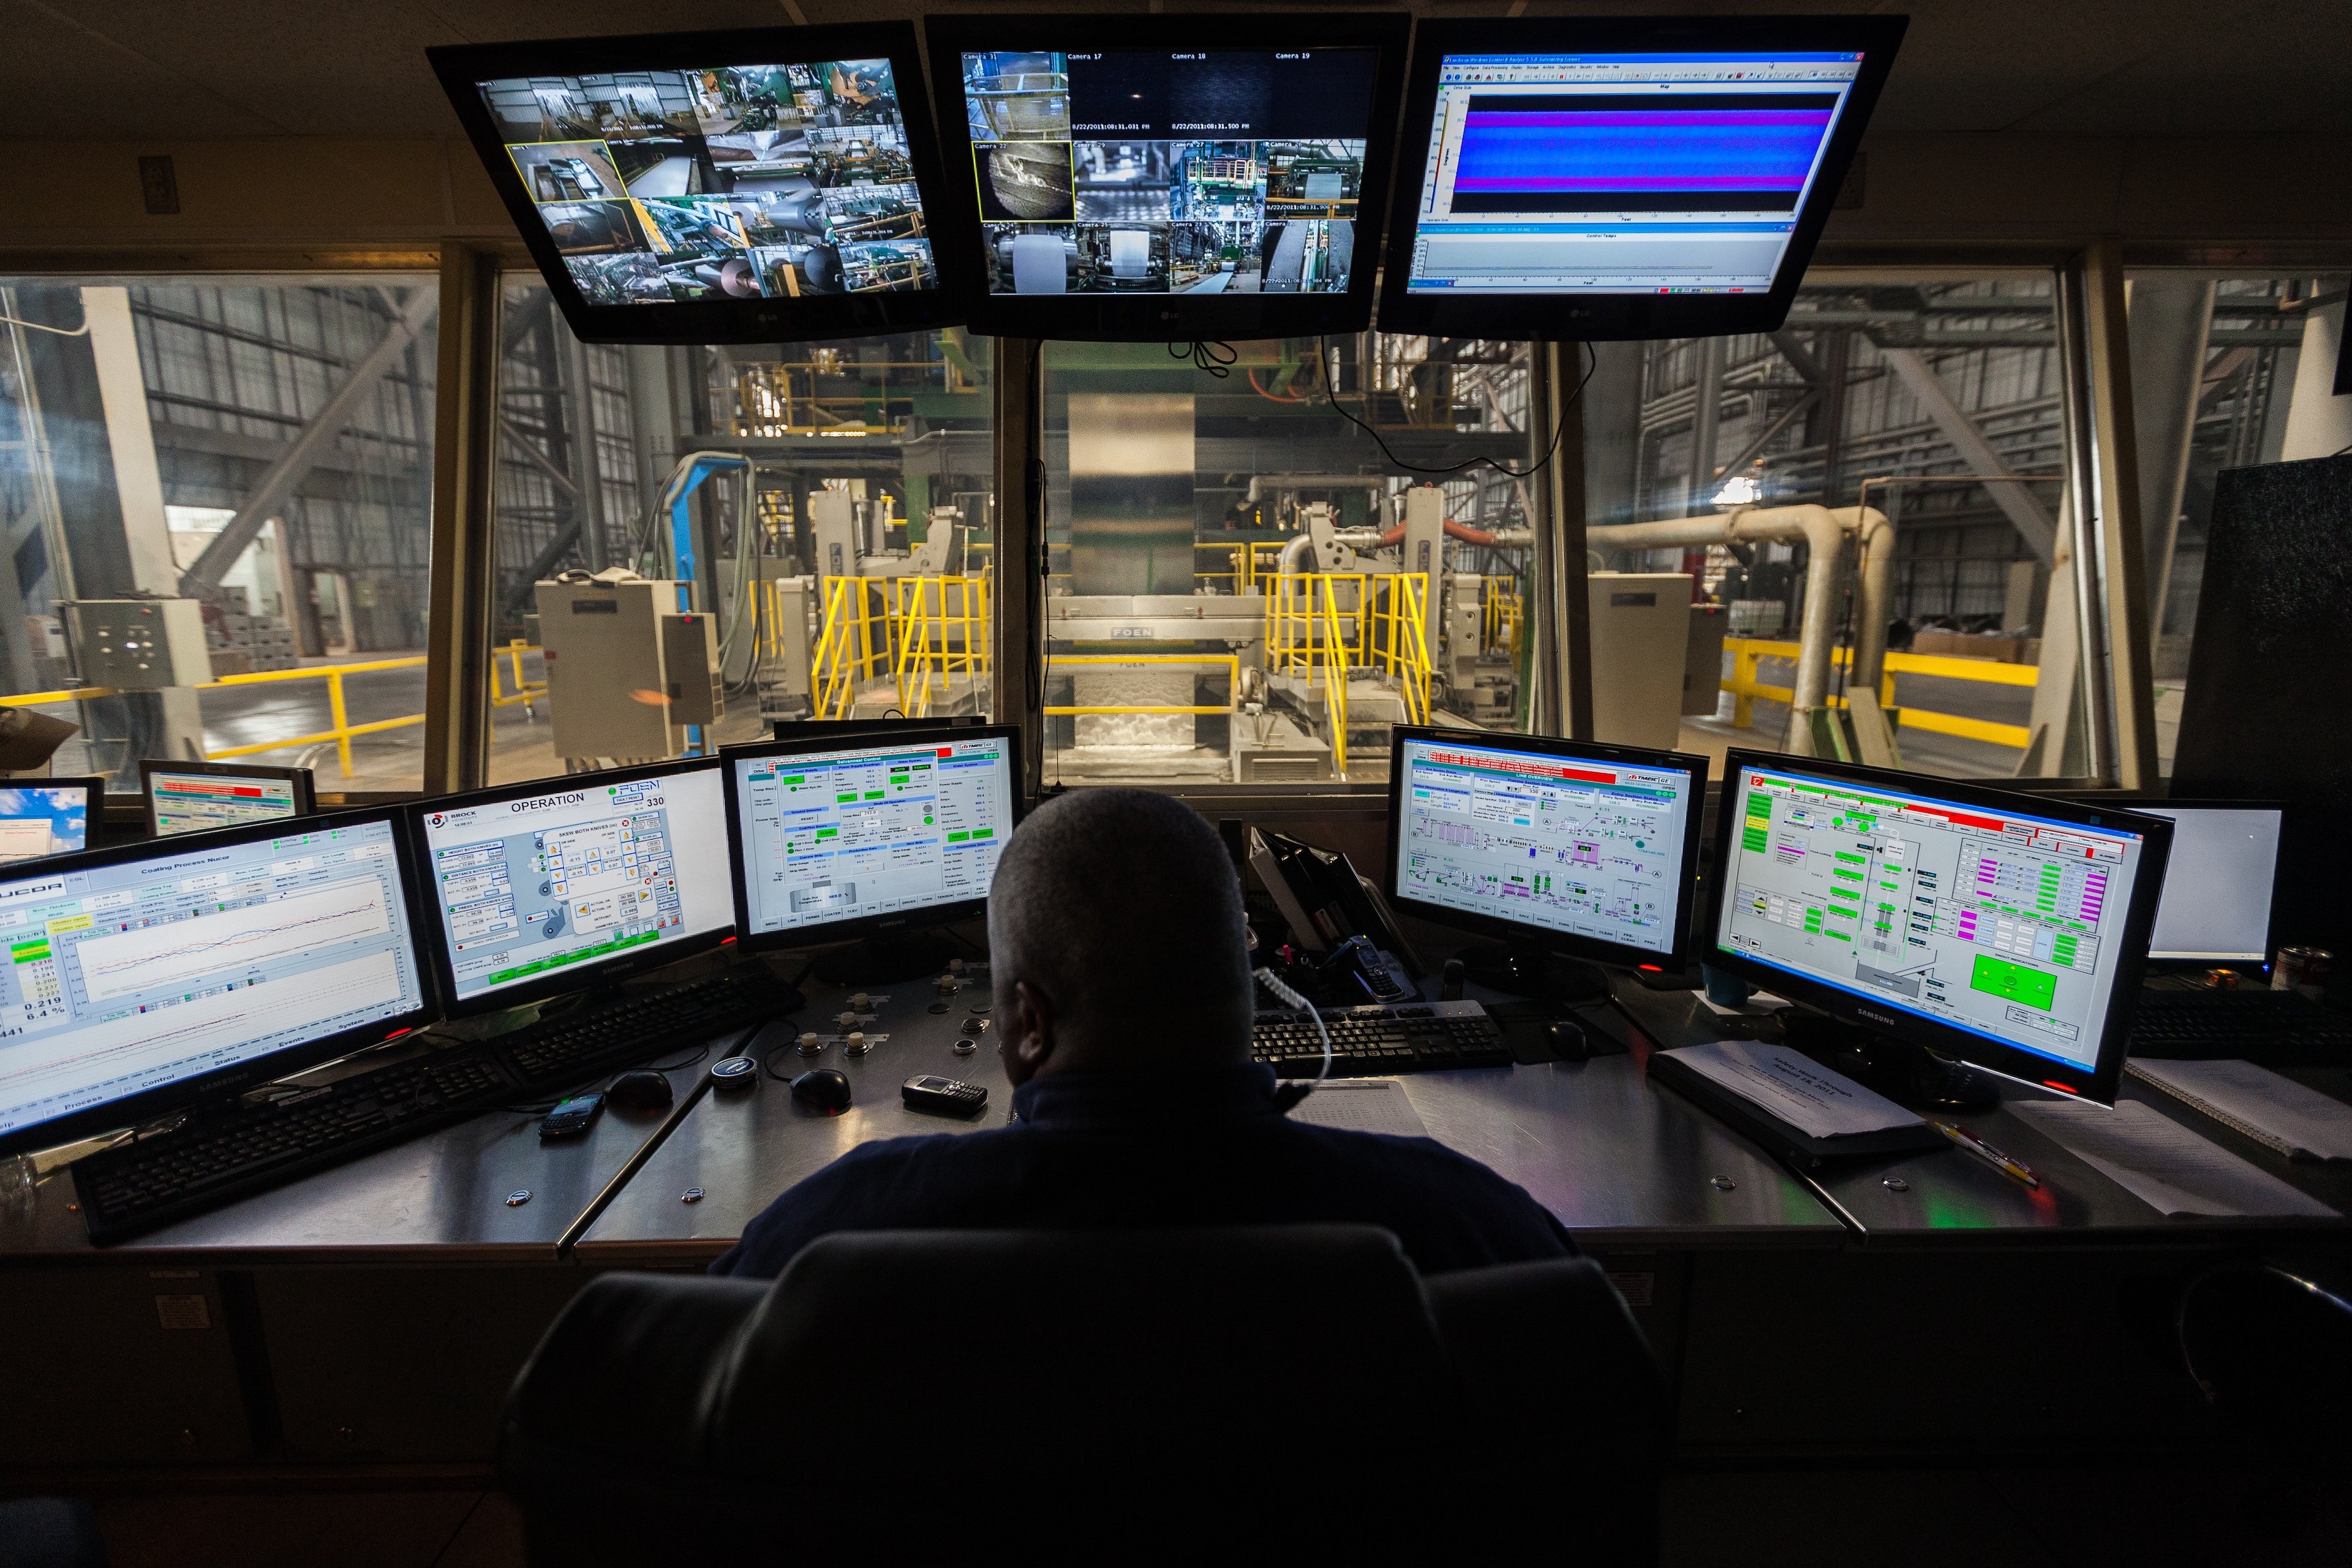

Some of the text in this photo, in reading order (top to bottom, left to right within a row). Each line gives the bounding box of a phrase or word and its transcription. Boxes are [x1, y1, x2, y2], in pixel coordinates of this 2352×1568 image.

[511, 793, 585, 813] OPERATION
[647, 797, 664, 807] 330
[451, 810, 477, 819] BROCK
[141, 865, 173, 874] Coating
[175, 859, 206, 868] Process
[0, 883, 62, 897] UCOR
[879, 919, 906, 928] SAMSUNG
[18, 947, 45, 956] Scanning
[518, 964, 541, 974] OPERATION
[603, 961, 635, 975] SAMSUNG
[2009, 957, 2039, 968] INDICATIONS
[39, 990, 60, 998] 0.223
[24, 997, 61, 1011] 0.219
[27, 1010, 48, 1020] 6.4
[1858, 1008, 1895, 1026] SAMSUNG
[338, 1018, 364, 1030] System
[279, 1036, 305, 1047] Events
[214, 1054, 241, 1066] Status
[141, 1074, 175, 1088] Control
[199, 1073, 249, 1092] SAMSUNG
[1772, 1063, 1836, 1096] August 18, 2011
[1774, 1057, 1853, 1098] Safety Walk Through
[64, 1095, 103, 1110] Process
